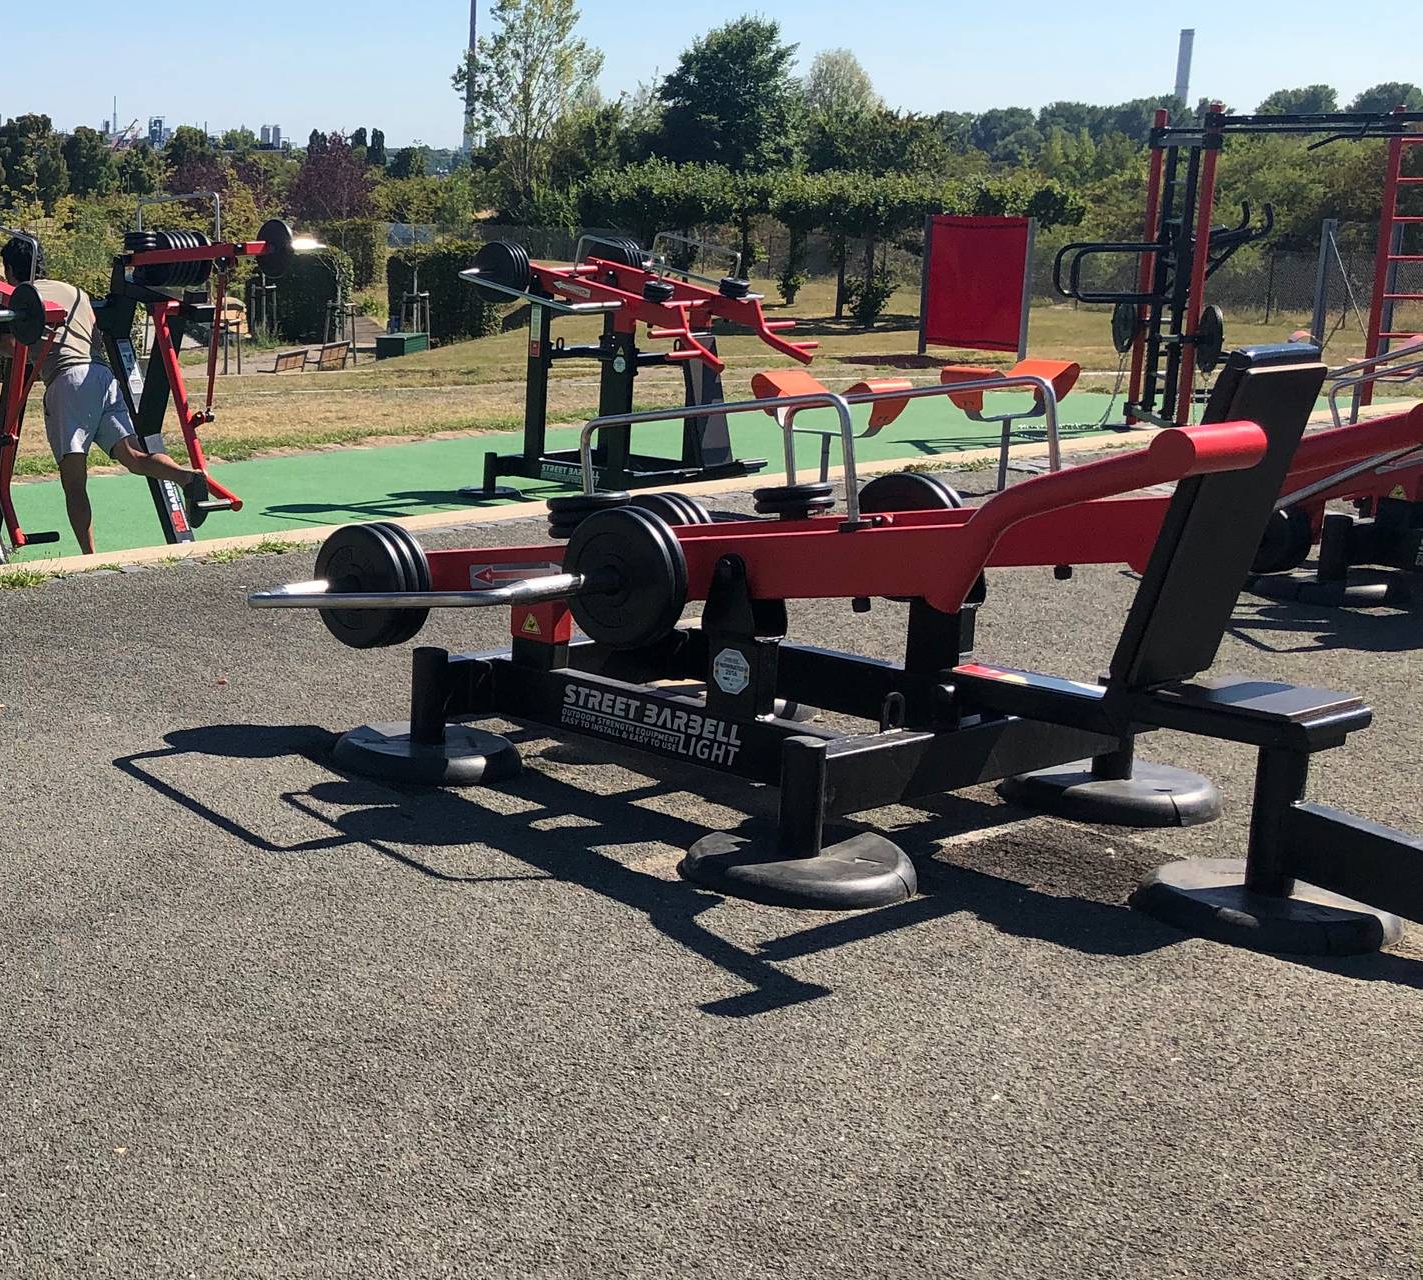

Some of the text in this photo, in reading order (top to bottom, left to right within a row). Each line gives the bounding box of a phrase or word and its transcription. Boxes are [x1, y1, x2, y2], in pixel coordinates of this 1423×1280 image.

[542, 464, 567, 474] STREET
[562, 708, 678, 744] OUTDOOR STRENGTH EQUIPMENT
[564, 684, 742, 746] STREET BARBELL
[561, 717, 677, 751] EASY TO INSTALL & EASY TO USE
[678, 736, 740, 766] LIGHT
